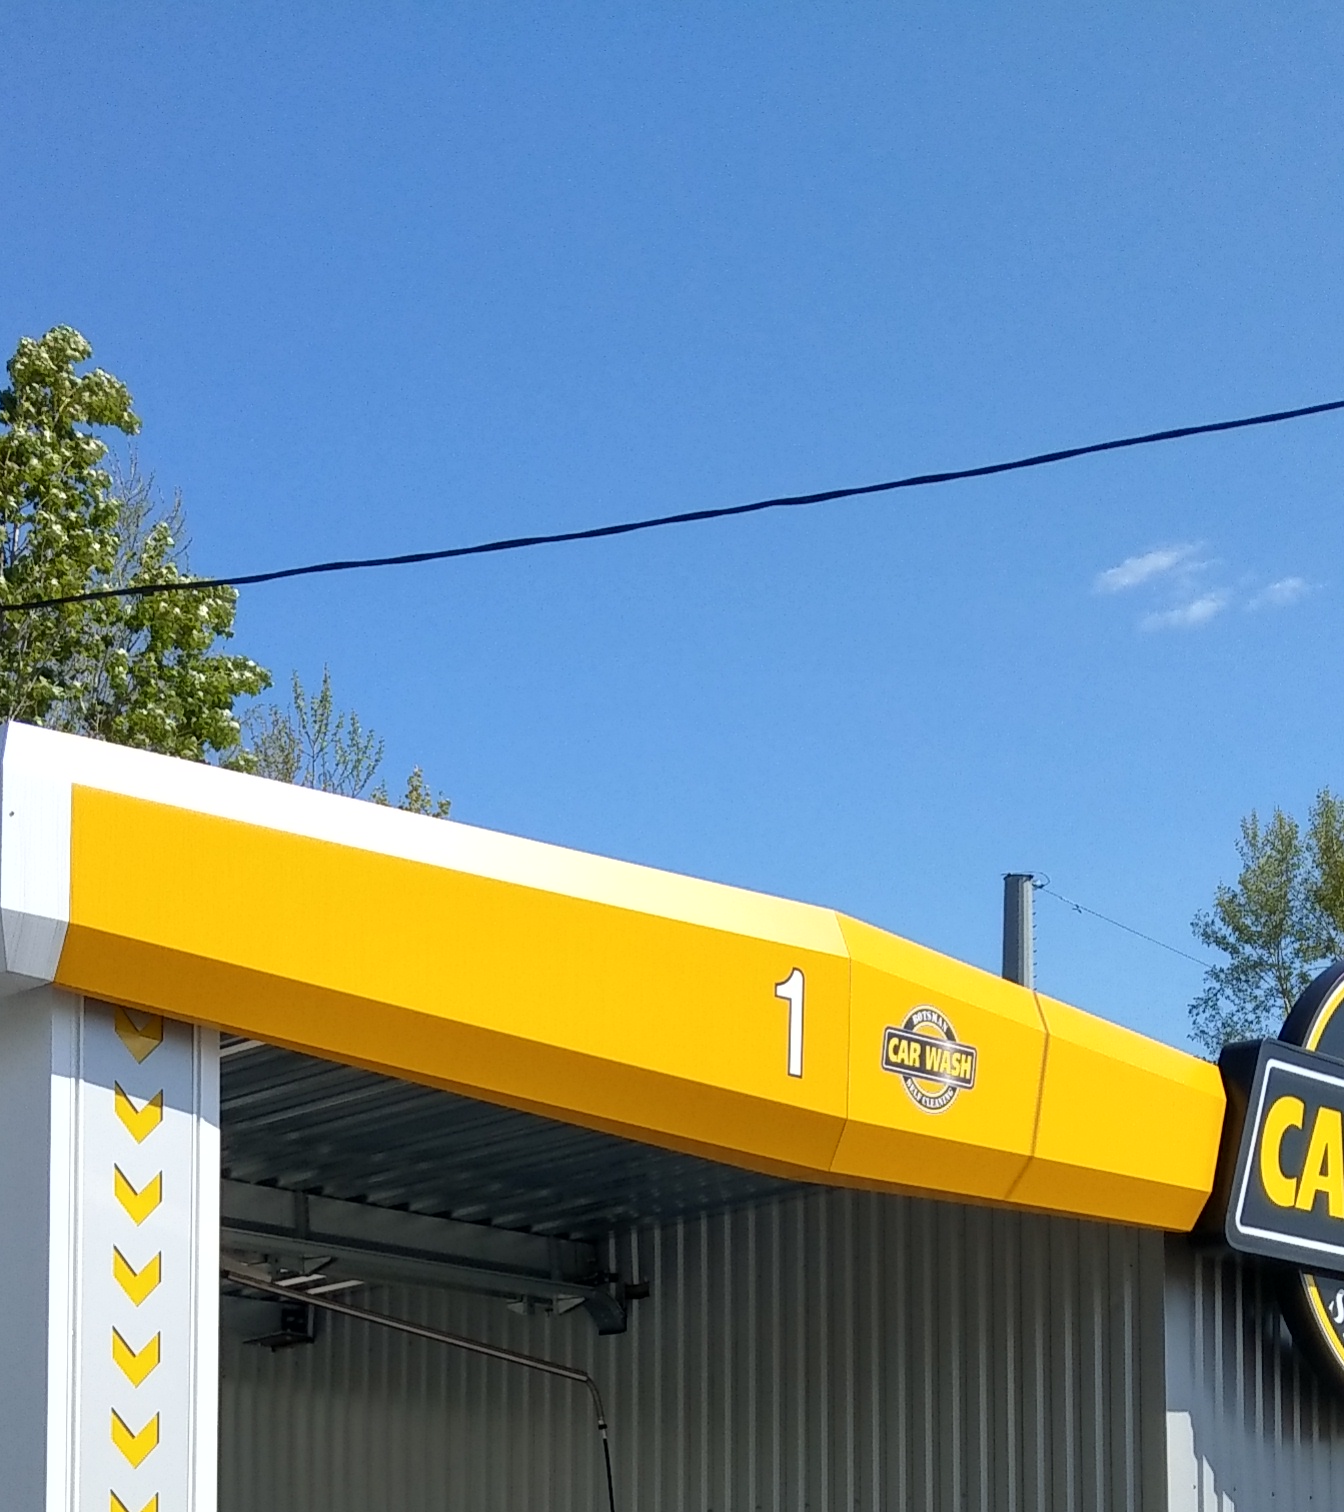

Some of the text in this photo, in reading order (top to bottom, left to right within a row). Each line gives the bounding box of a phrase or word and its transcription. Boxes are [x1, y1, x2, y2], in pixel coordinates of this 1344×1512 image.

[774, 966, 805, 1079] 1
[912, 1010, 948, 1033] BOTSMAN
[888, 1037, 973, 1080] CAR WASH
